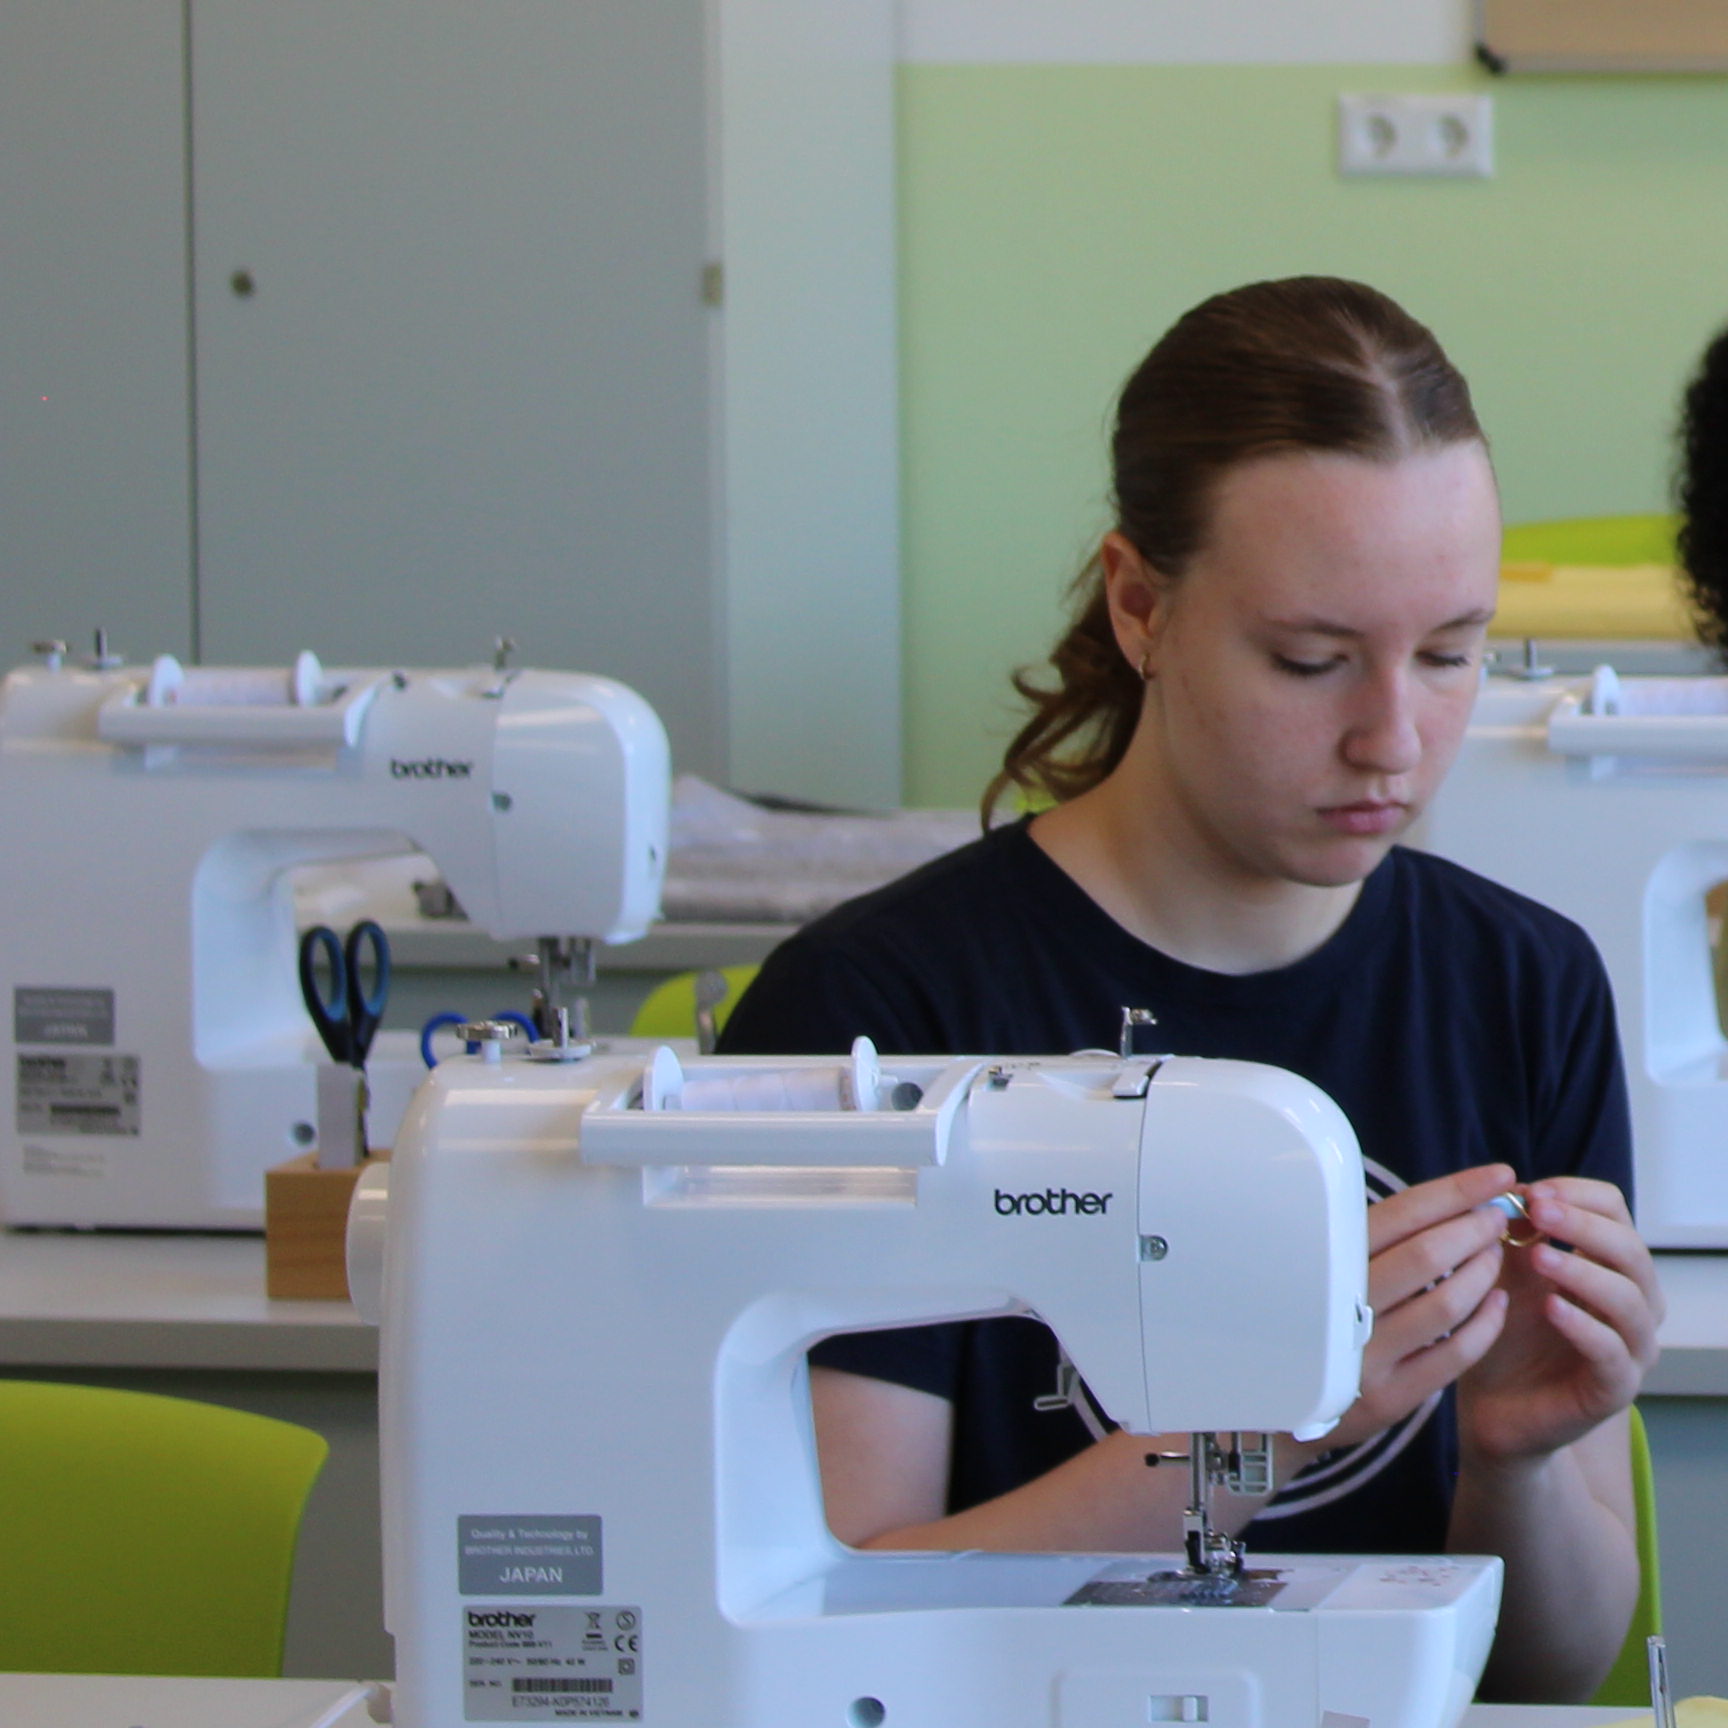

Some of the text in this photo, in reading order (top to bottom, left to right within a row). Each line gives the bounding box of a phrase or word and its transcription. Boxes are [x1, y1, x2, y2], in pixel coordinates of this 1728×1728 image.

[391, 758, 473, 778] brother
[994, 1188, 1113, 1215] brother
[471, 1529, 588, 1541] Quality & Technology by
[464, 1545, 512, 1556] BROTHER
[499, 1566, 563, 1583] JAPAN
[467, 1611, 536, 1627] brother
[468, 1630, 504, 1639] MODEL
